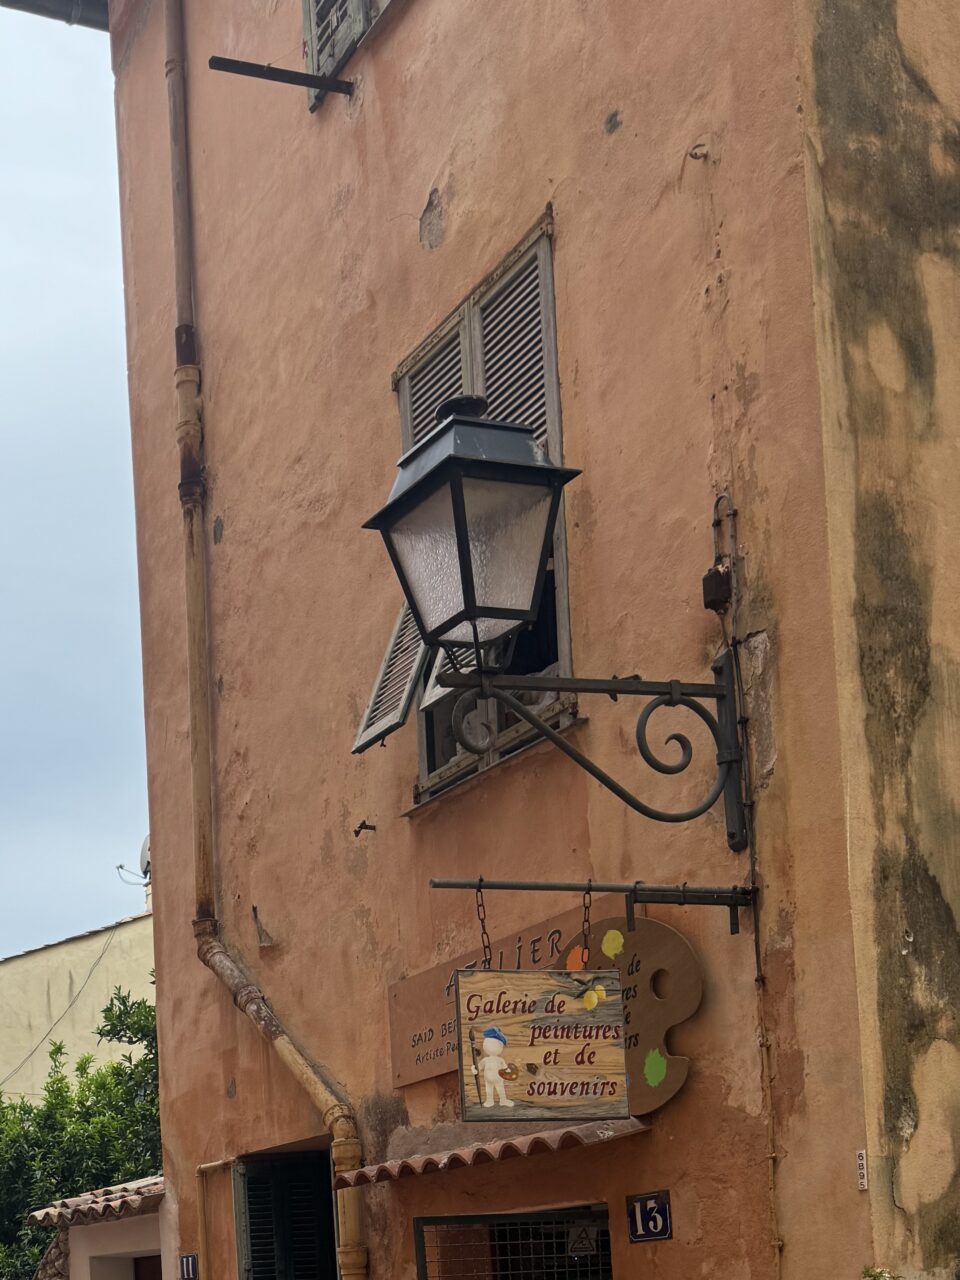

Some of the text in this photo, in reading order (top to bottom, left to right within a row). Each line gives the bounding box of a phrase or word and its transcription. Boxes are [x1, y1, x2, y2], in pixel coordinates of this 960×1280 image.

[466, 991, 566, 1021] Galerie de
[529, 1019, 621, 1046] peintures
[543, 1043, 596, 1065] et de
[527, 1075, 617, 1096] souvenirs
[634, 1200, 663, 1235] 13
[182, 1257, 194, 1278] 11
